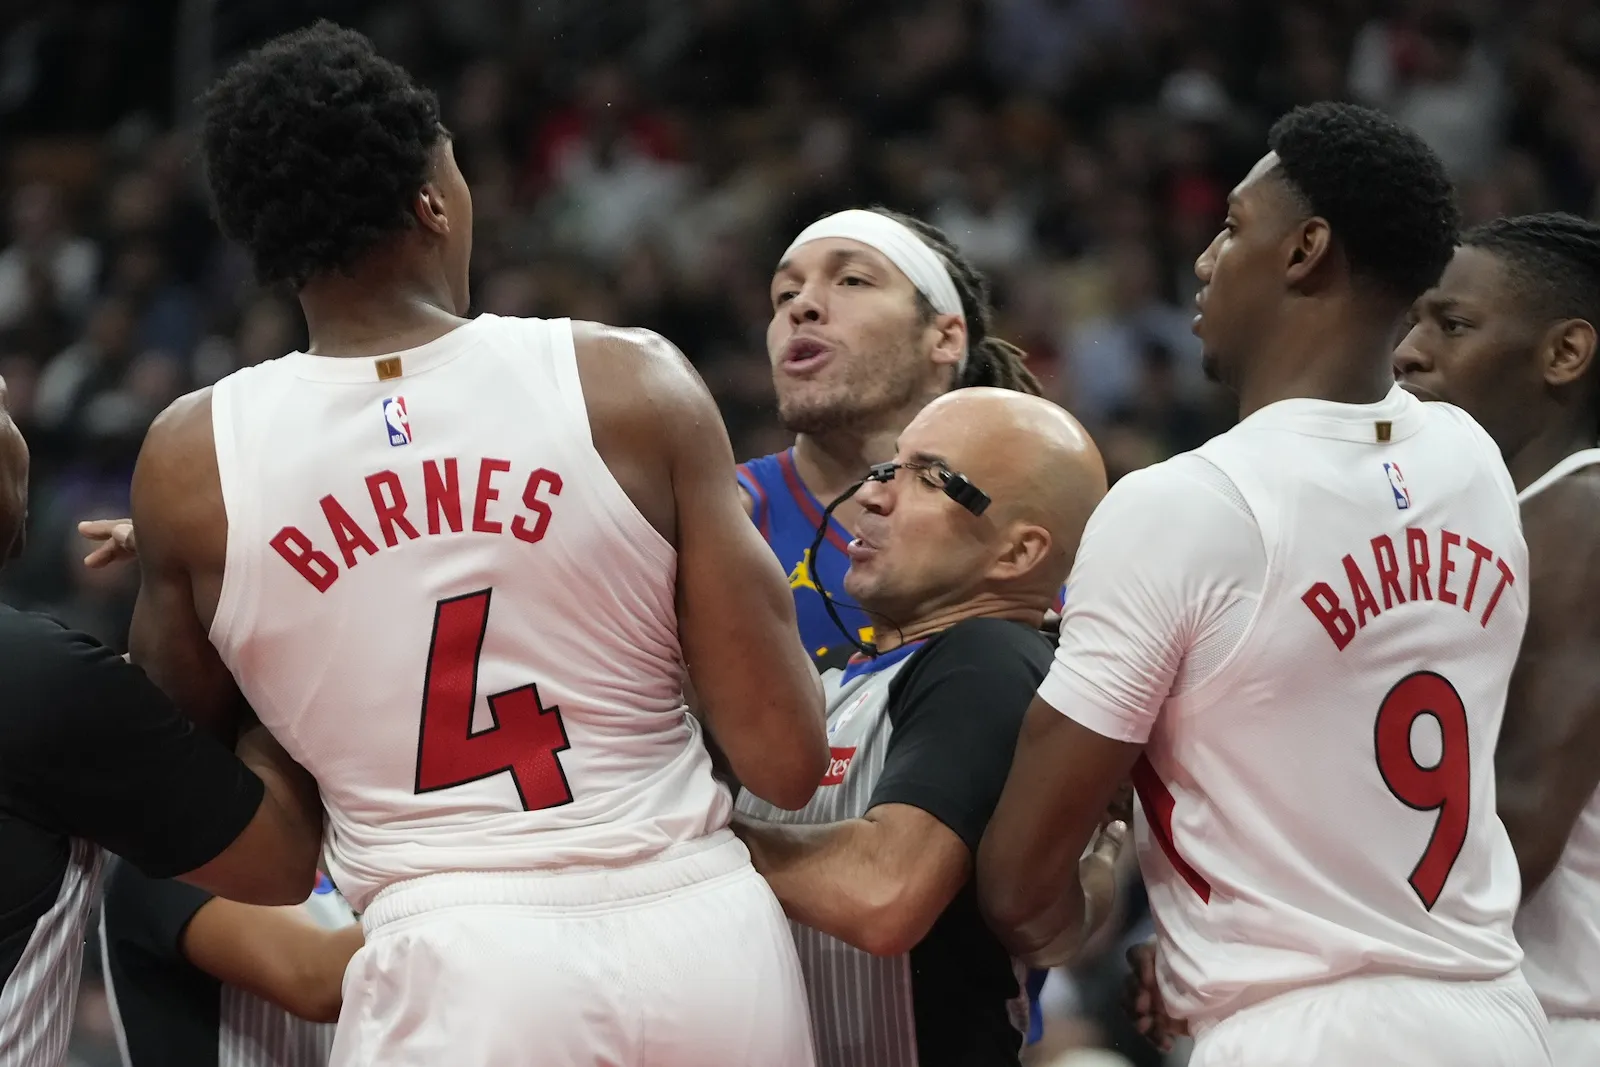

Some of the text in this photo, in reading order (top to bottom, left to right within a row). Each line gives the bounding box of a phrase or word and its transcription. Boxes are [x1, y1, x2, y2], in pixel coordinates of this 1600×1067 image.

[391, 433, 405, 445] NBA
[269, 457, 563, 593] BARNES
[1301, 527, 1515, 651] BARRETT
[414, 587, 574, 812] 4
[1374, 670, 1470, 912] 9
